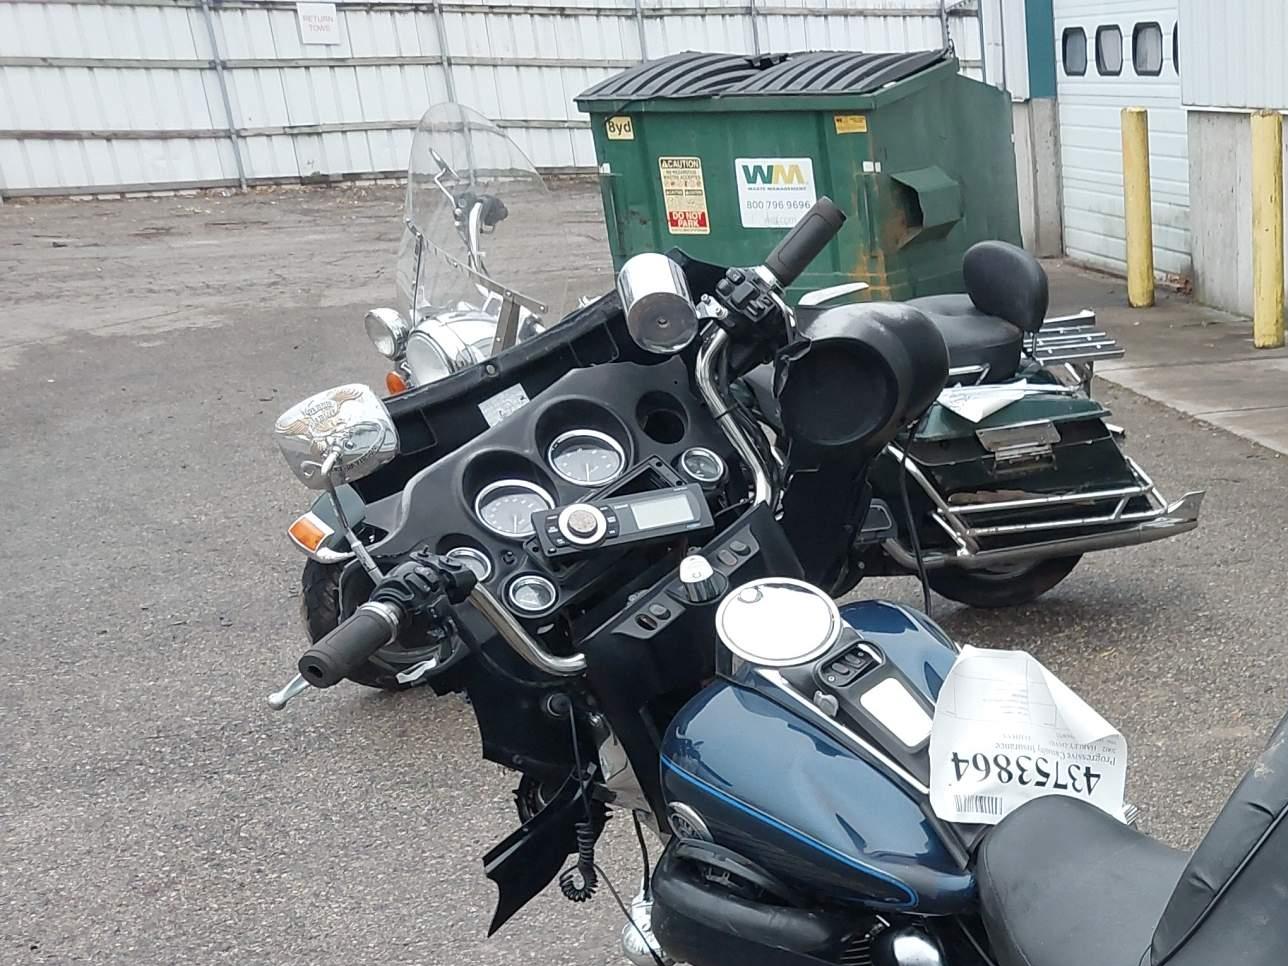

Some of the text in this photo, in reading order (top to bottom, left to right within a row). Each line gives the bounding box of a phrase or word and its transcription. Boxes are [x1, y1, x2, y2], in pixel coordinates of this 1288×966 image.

[608, 120, 632, 136] 8yd
[667, 159, 699, 170] CAUTION
[742, 164, 806, 185] WM
[746, 200, 764, 210] 800
[786, 200, 811, 210] 9696
[672, 210, 703, 220] DO NOT
[678, 219, 700, 228] PARK
[1066, 751, 1117, 767] Progressive
[951, 752, 1101, 796] 43753864
